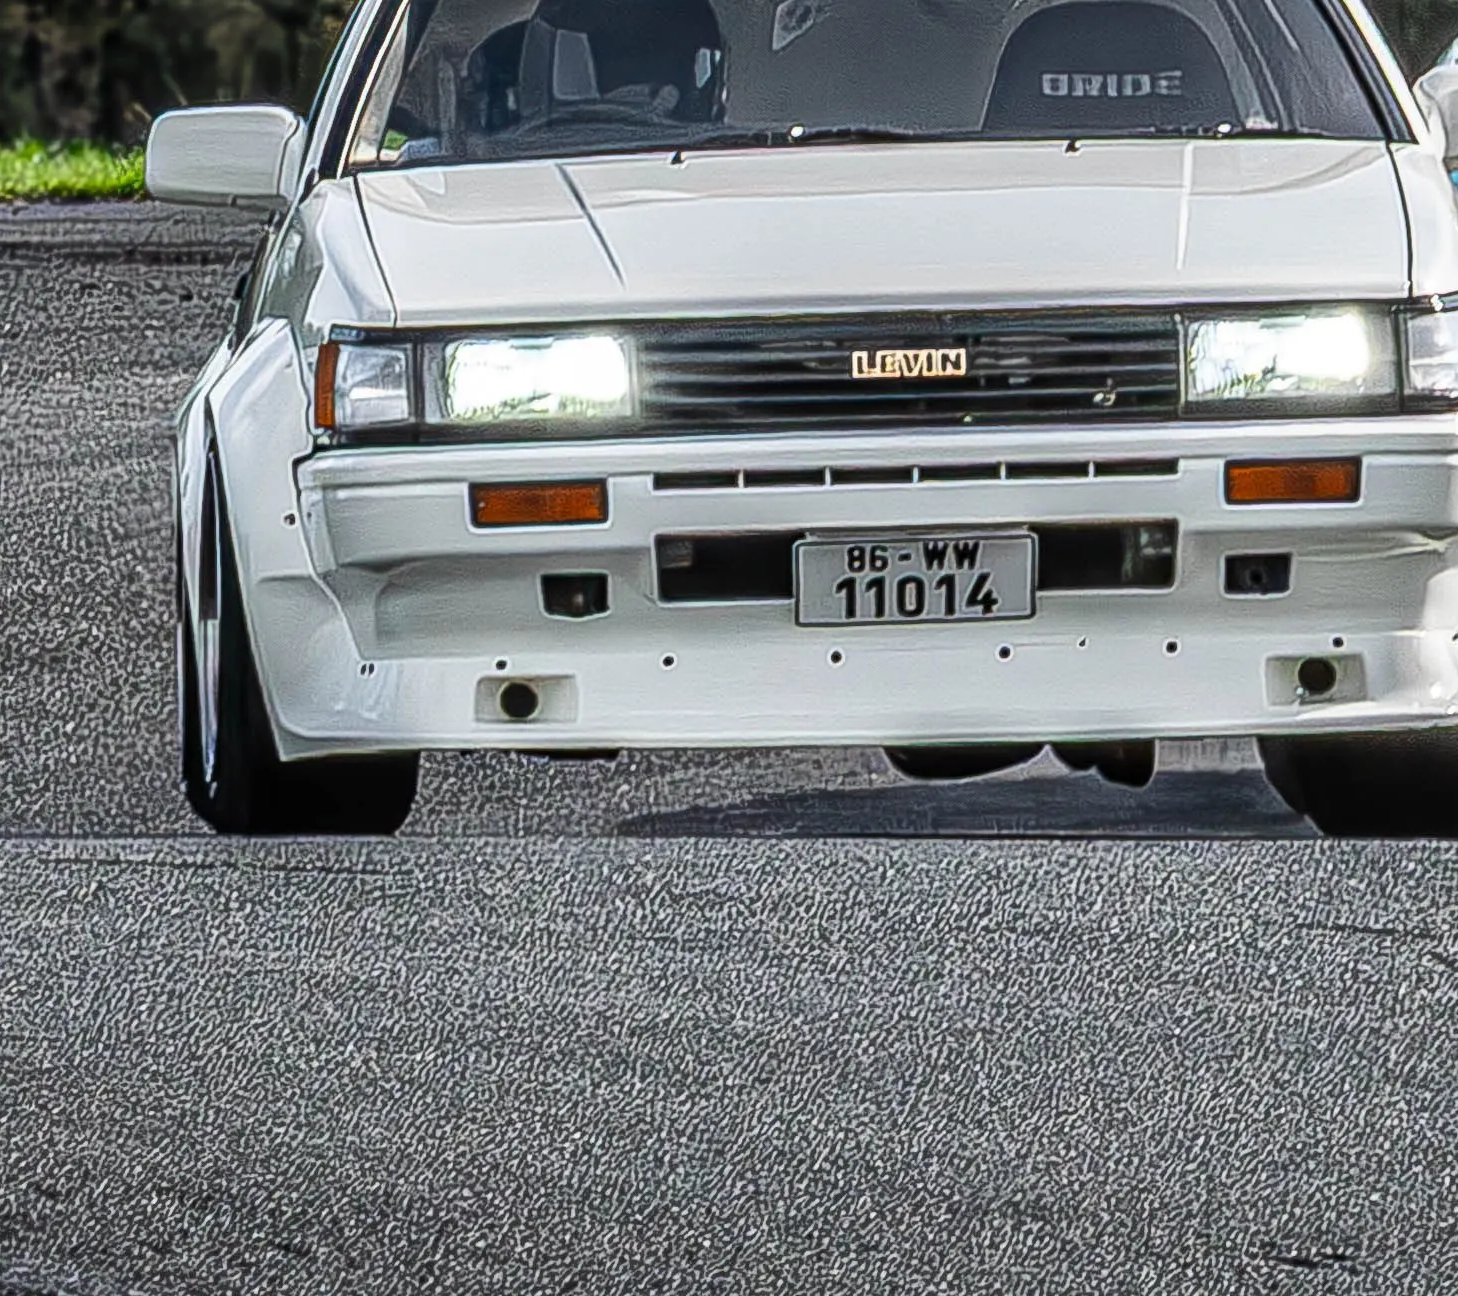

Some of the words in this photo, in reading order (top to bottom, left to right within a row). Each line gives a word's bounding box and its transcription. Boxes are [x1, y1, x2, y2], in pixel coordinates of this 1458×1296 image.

[1042, 70, 1183, 97] BRIDE
[851, 348, 967, 379] LEVIN
[834, 571, 999, 620] 11014
